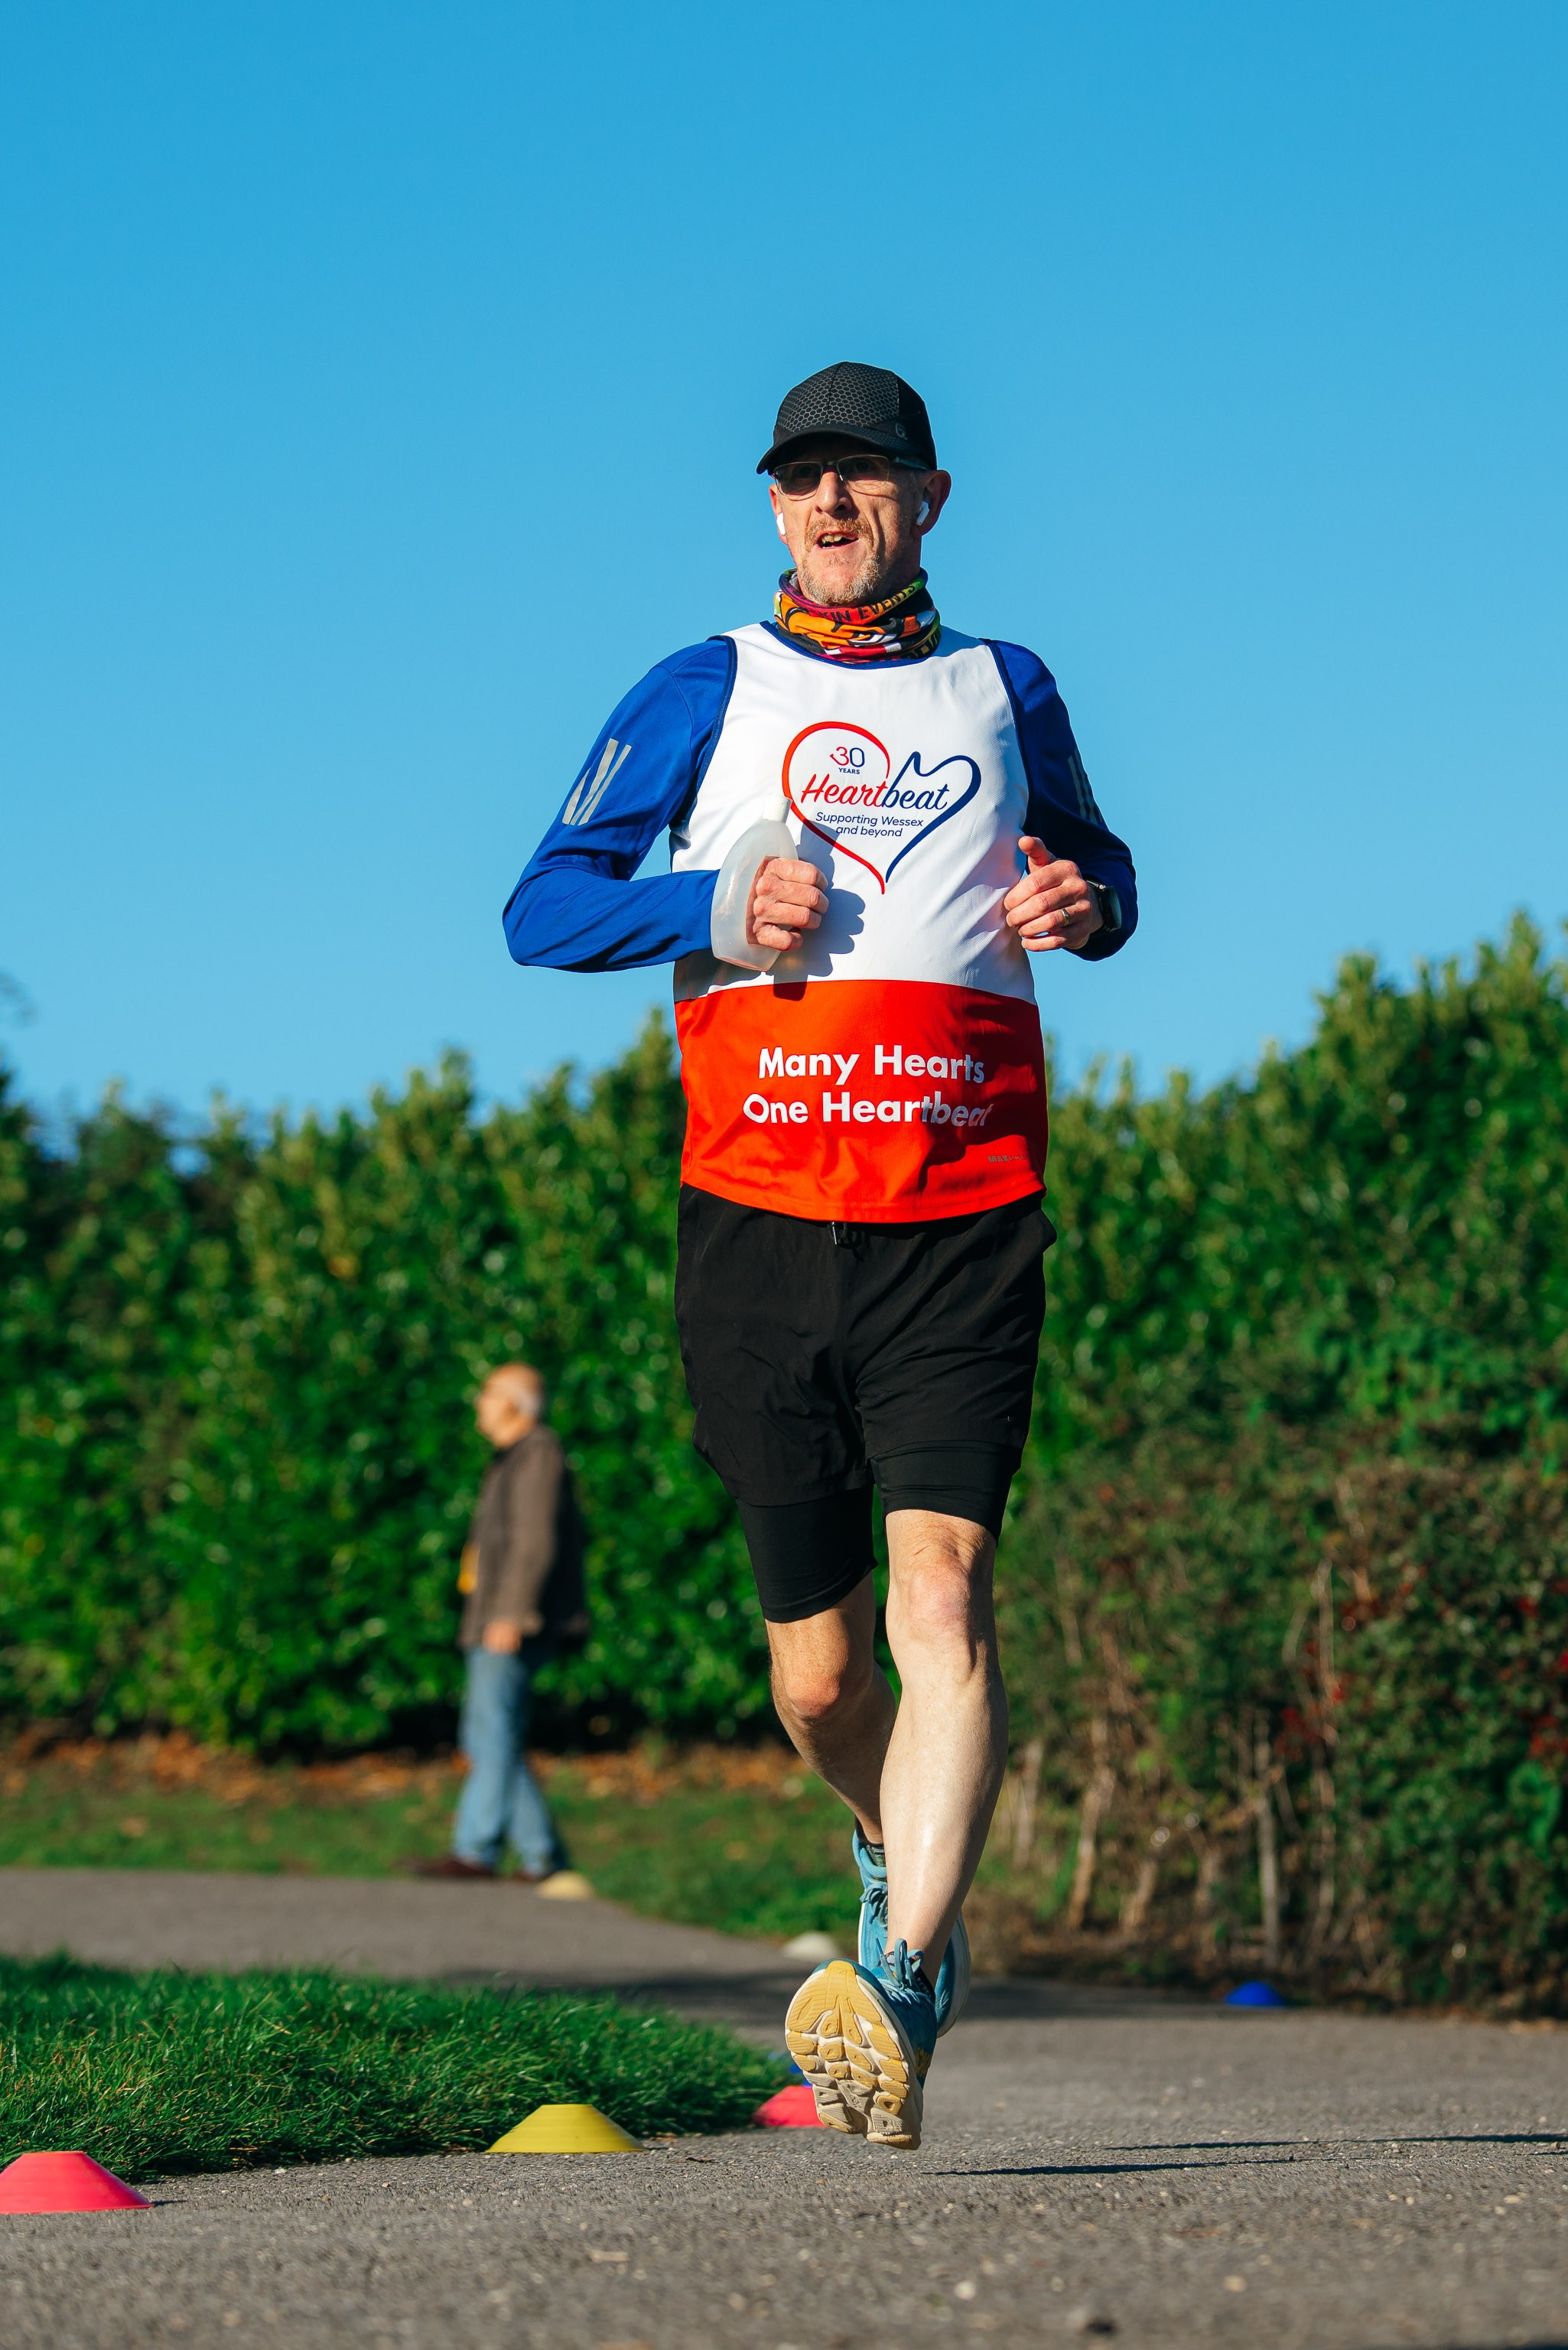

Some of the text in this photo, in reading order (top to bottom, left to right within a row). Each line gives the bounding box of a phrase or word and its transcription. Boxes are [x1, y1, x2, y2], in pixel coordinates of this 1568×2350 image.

[830, 747, 865, 767] 30
[801, 773, 950, 810] Heartbeat
[815, 812, 924, 827] Supporting Wessex
[836, 826, 903, 838] and beyond
[758, 1045, 984, 1085] Many Hearts
[743, 1091, 994, 1127] One Heartbeat
